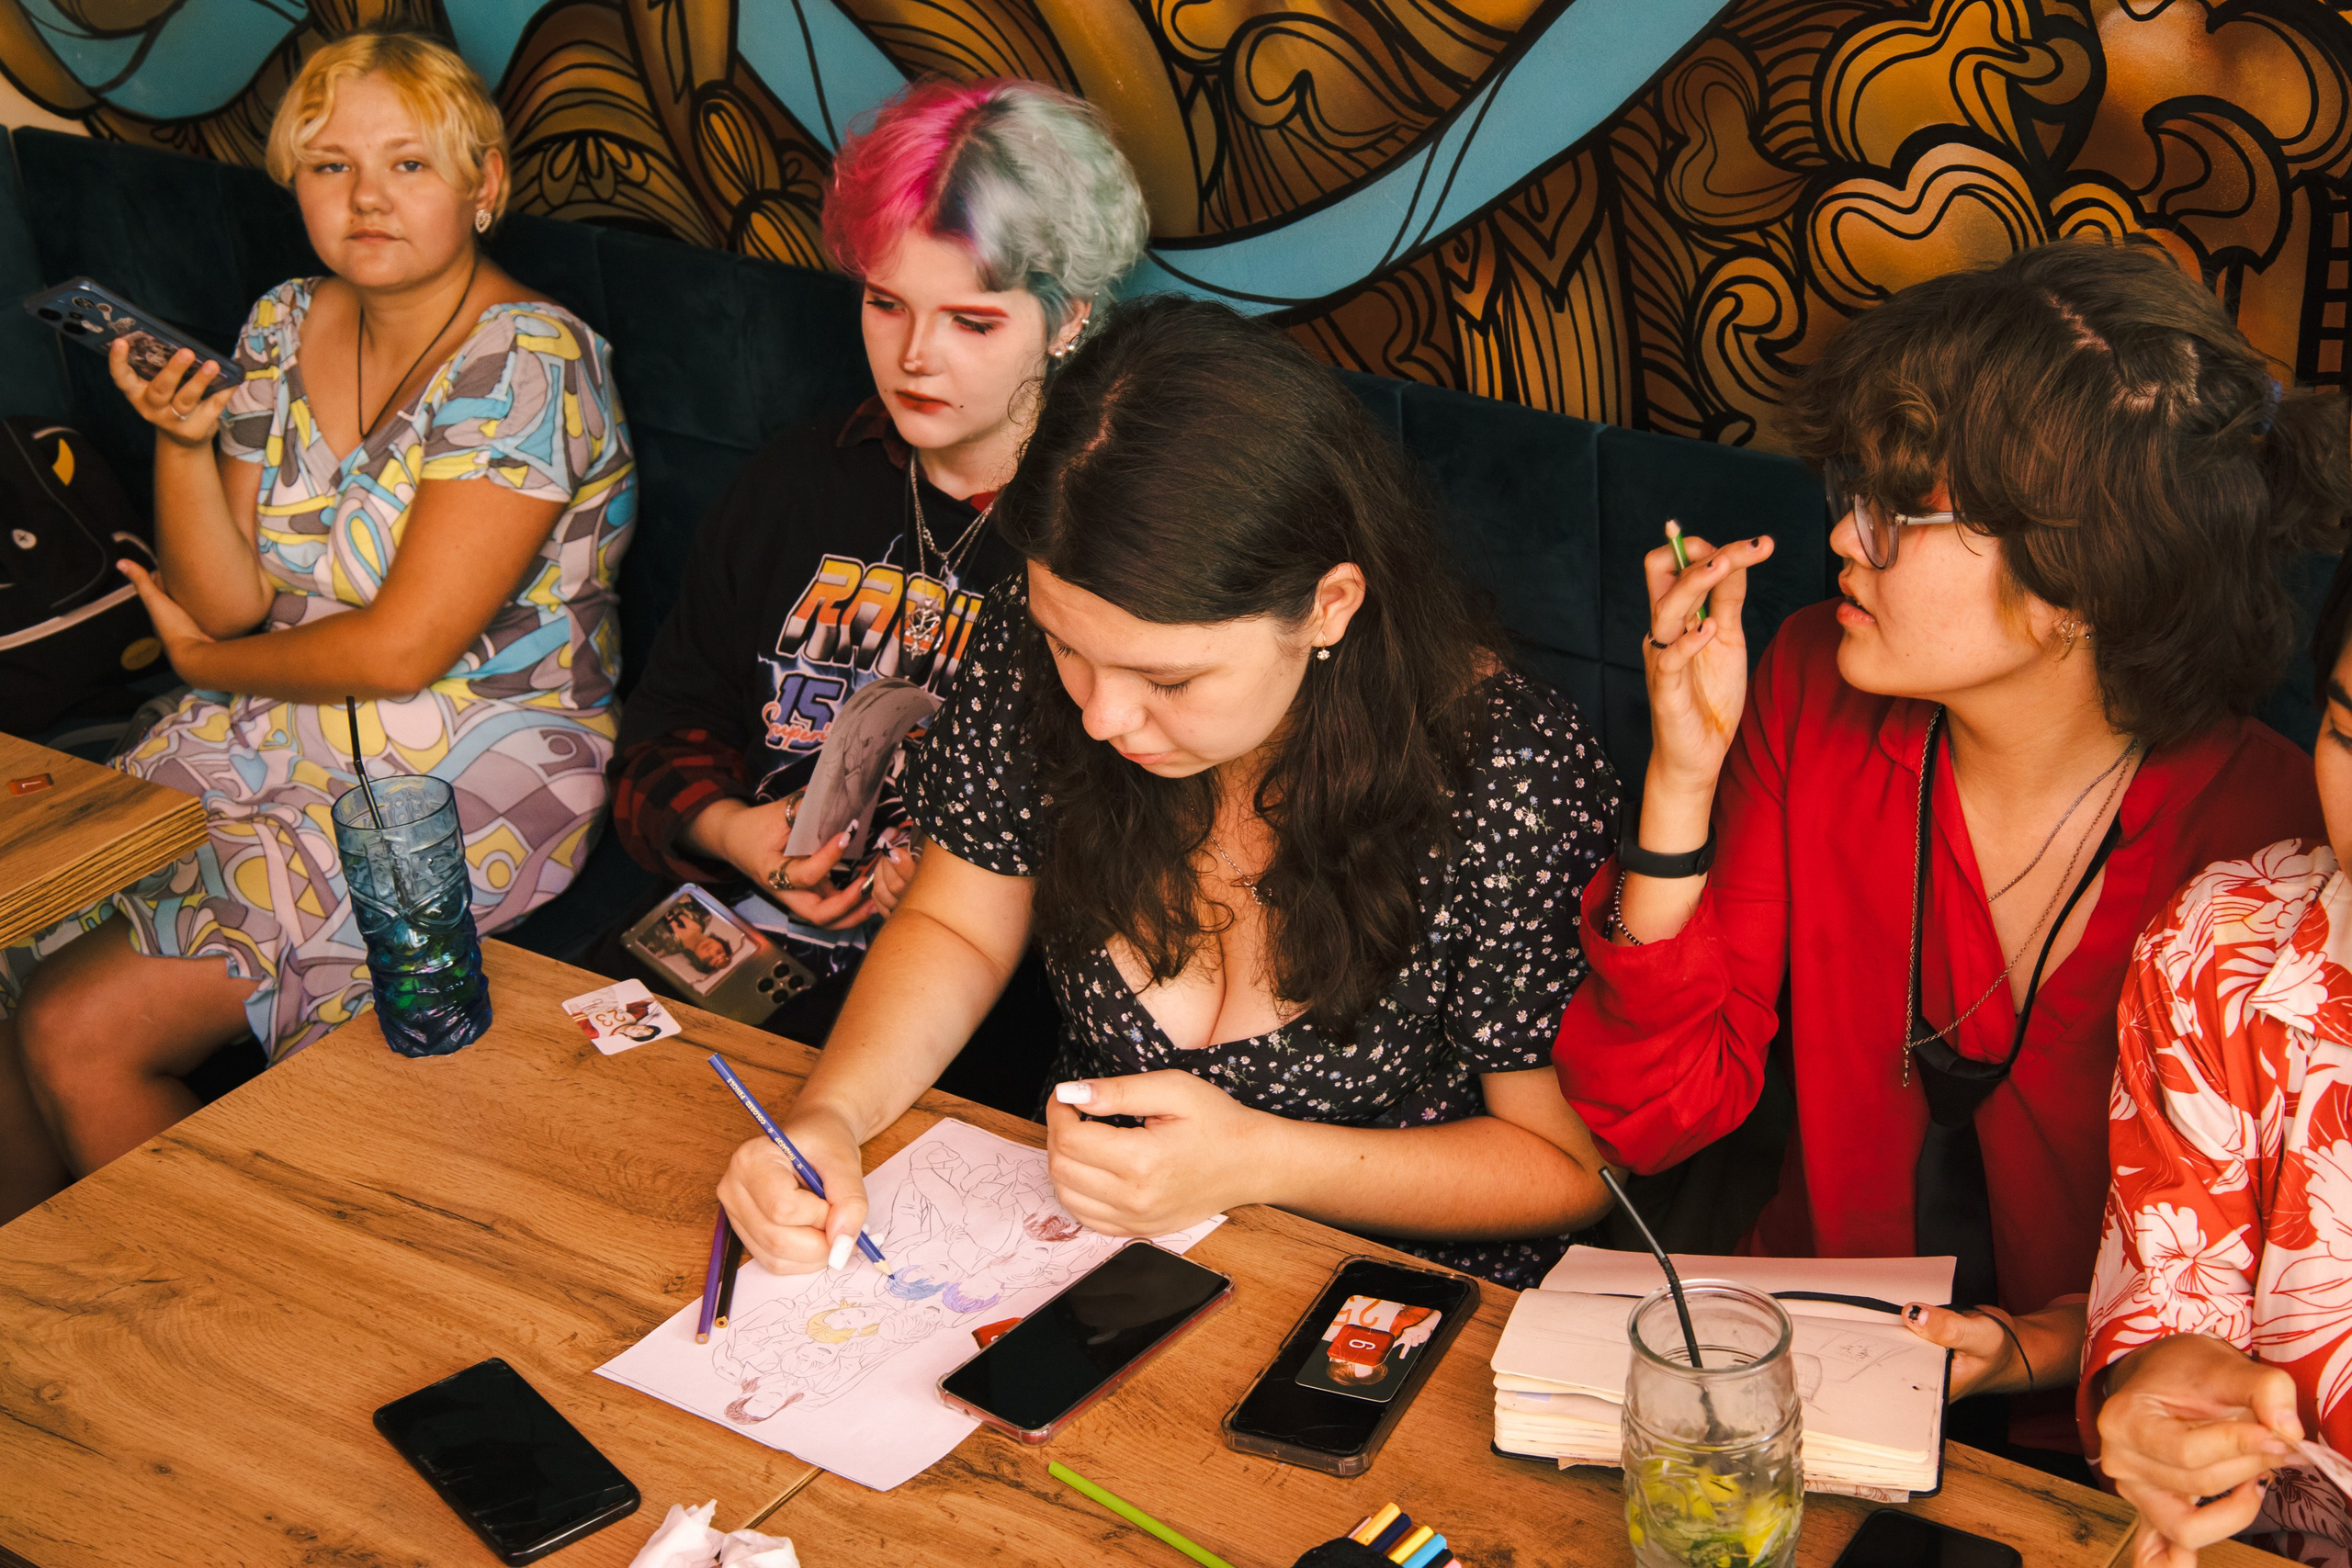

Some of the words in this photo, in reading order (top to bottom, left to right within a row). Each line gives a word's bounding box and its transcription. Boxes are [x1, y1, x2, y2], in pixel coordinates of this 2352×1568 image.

[766, 671, 847, 752] 15
[595, 1009, 626, 1027] 23
[727, 1077, 745, 1100] PENCILS
[745, 1100, 766, 1125] COLORED
